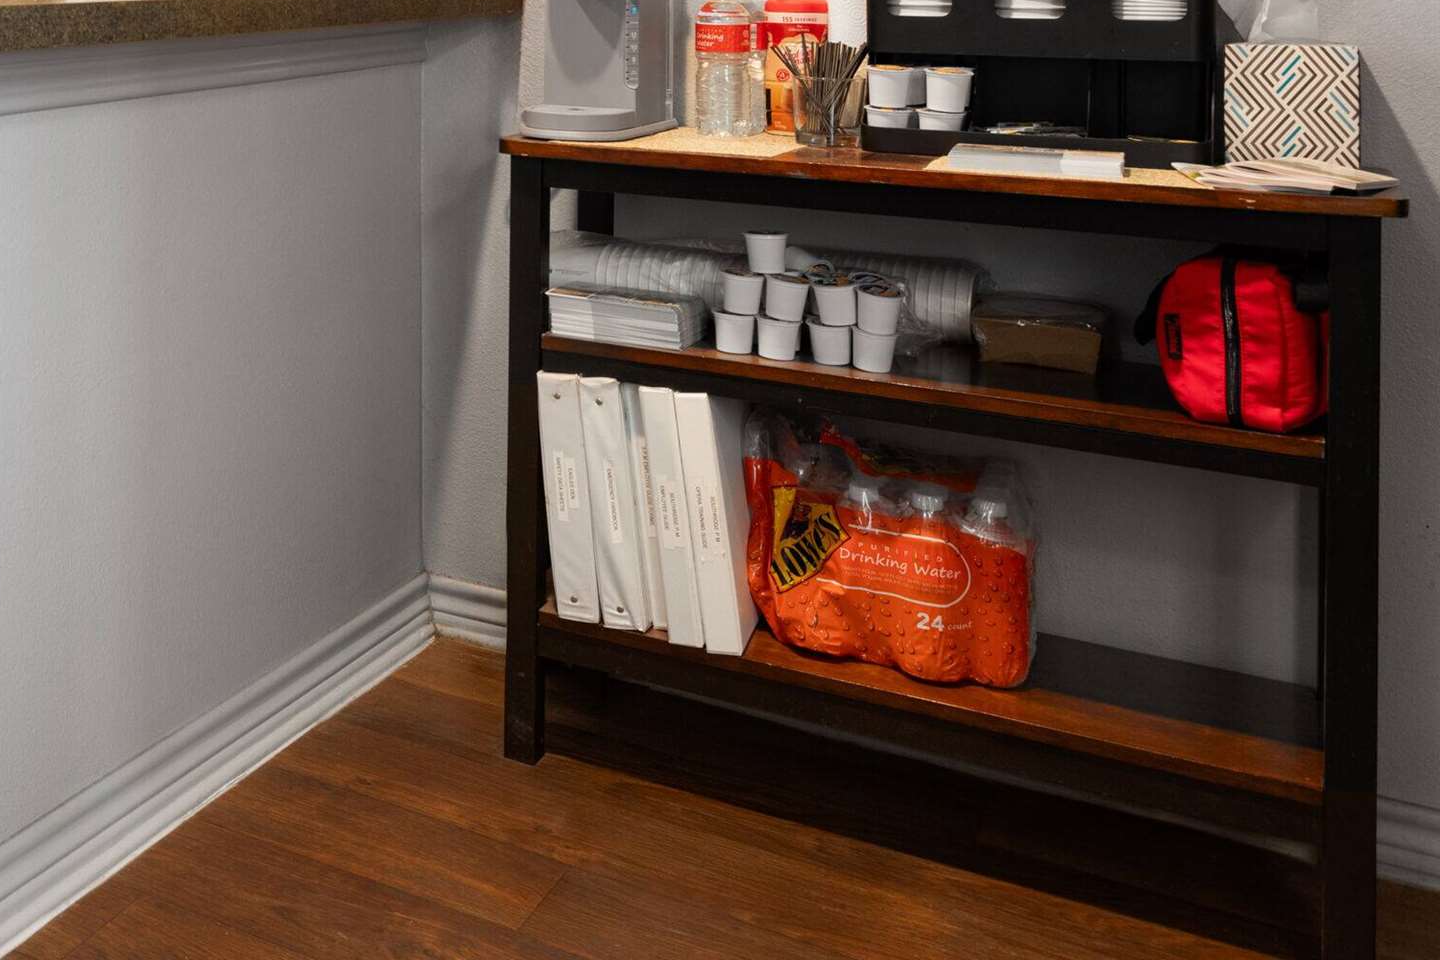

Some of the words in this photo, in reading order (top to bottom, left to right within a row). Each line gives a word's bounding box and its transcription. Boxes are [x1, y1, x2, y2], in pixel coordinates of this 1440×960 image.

[858, 542, 943, 562] PURIFIED
[839, 547, 908, 574] Drinking
[914, 563, 960, 580] Water
[916, 612, 945, 632] 24
[947, 621, 973, 631] count
